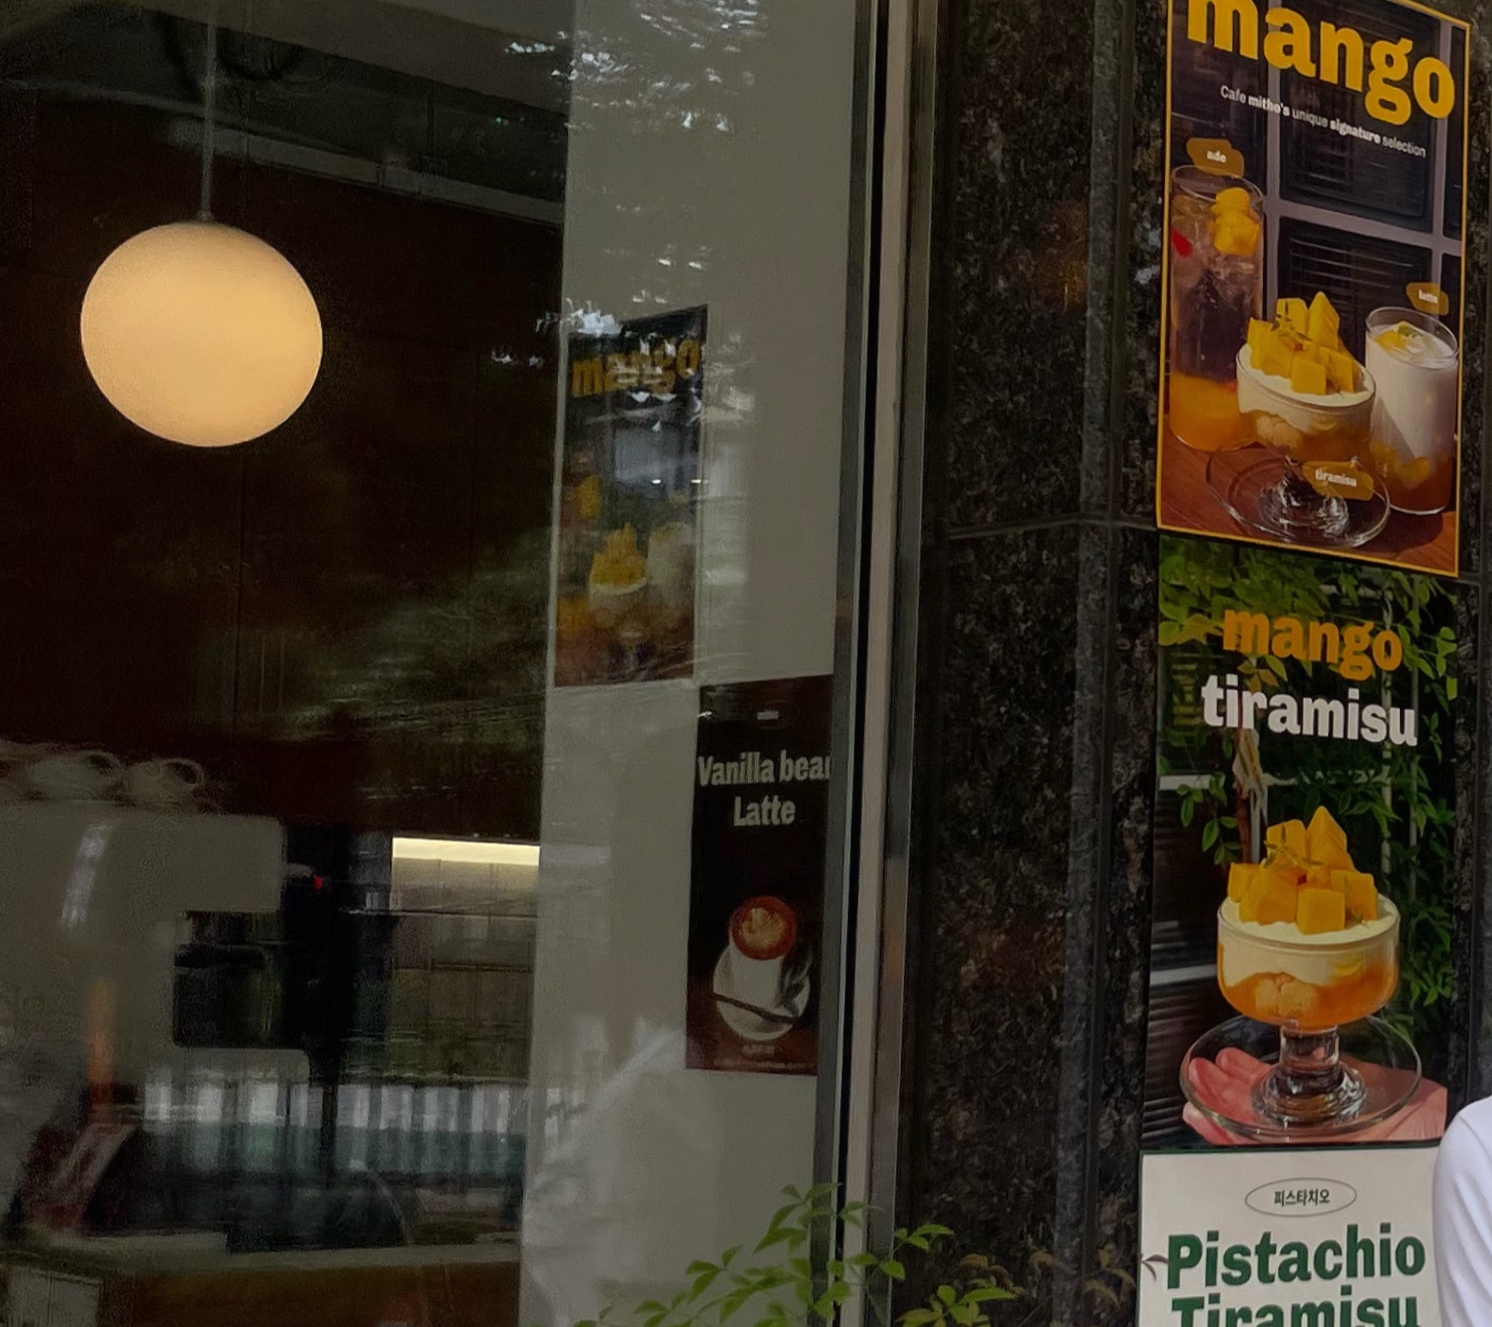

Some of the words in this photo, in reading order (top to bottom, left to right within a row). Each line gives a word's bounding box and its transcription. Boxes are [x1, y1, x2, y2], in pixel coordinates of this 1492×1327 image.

[1221, 85, 1246, 103] Cafe
[1248, 94, 1290, 117] mitho's
[1292, 108, 1328, 128] unique
[1330, 118, 1382, 145] signature
[1382, 135, 1426, 159] selection
[1315, 467, 1357, 488] tiramisu
[1222, 608, 1403, 681] mango
[1201, 673, 1418, 747] tiramisu
[697, 751, 776, 787] Vanilla
[733, 794, 796, 827] Latte
[1274, 1188, 1330, 1207] 피스타치오
[1167, 1222, 1426, 1289] Pistachio
